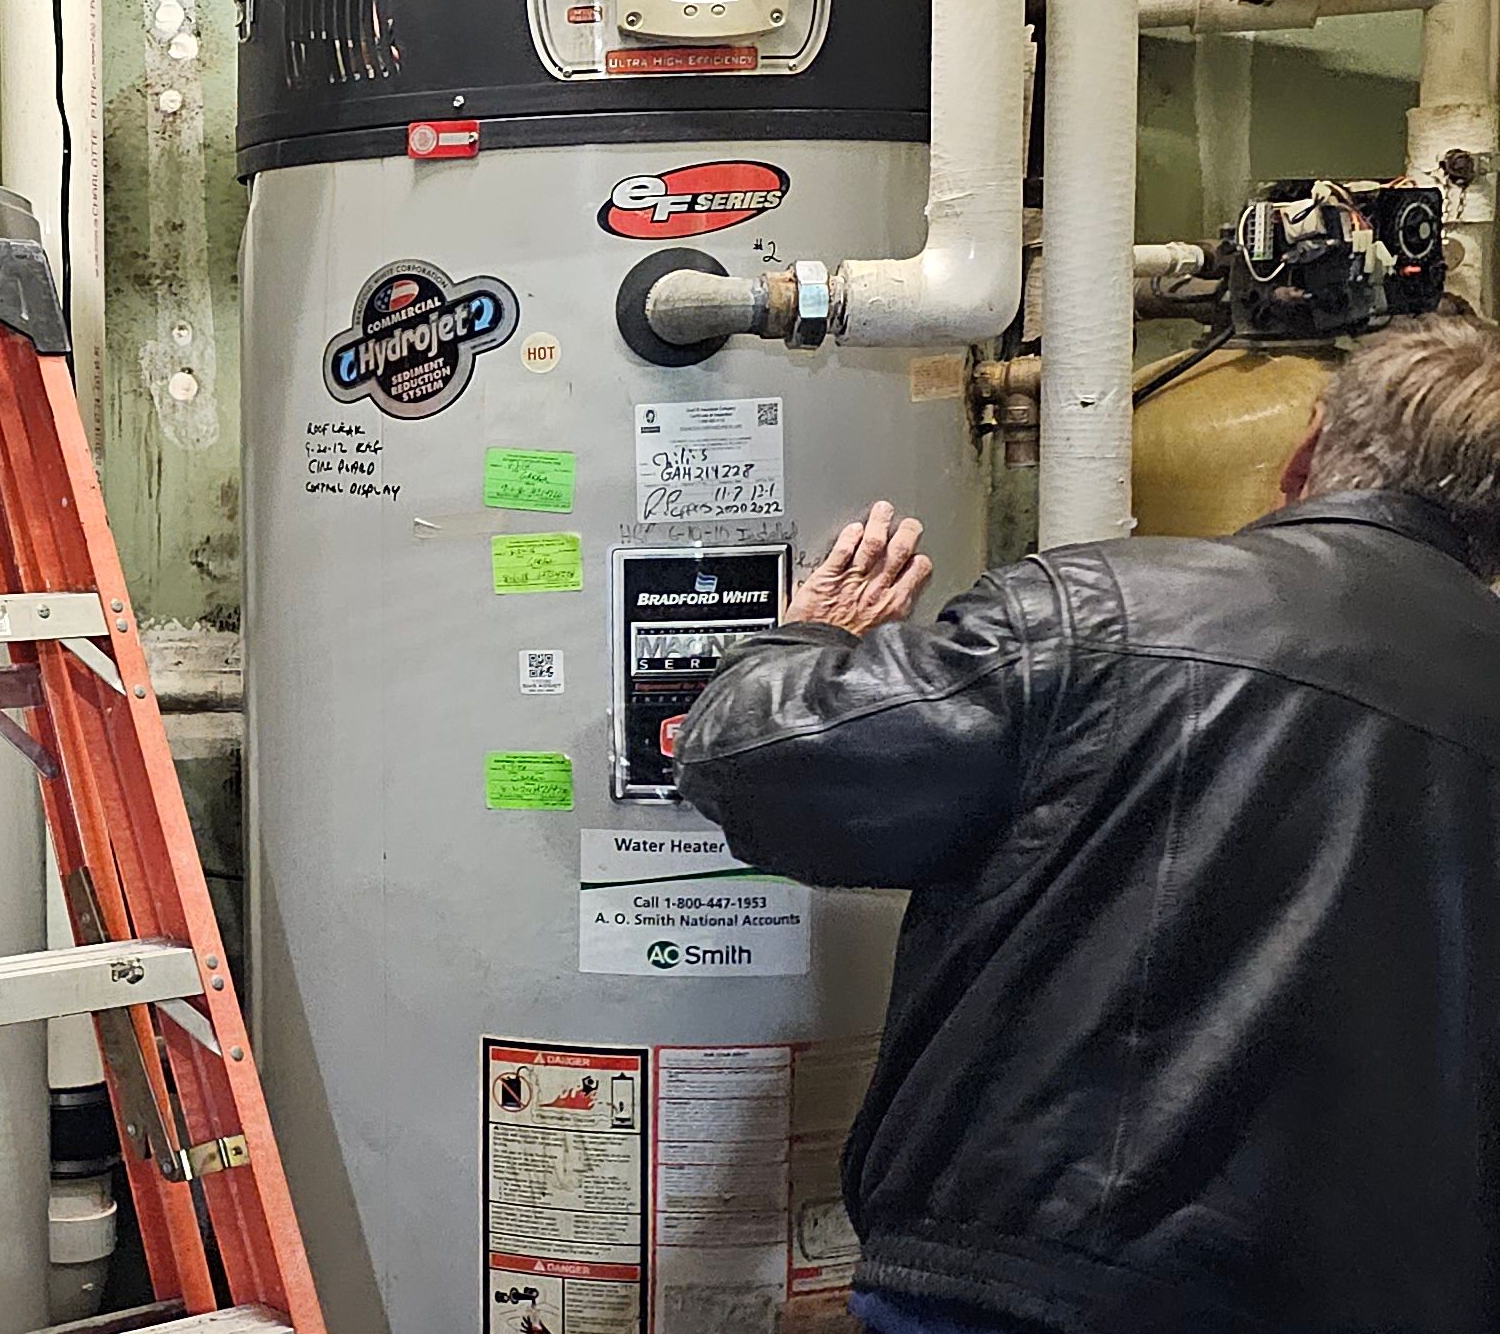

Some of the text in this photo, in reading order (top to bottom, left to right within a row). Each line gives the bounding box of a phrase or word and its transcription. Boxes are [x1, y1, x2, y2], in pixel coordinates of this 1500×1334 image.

[609, 54, 754, 68] ULTRA HIGH EFFICIENCY
[694, 190, 783, 211] SERIES
[395, 265, 448, 289] CORPORATION
[366, 296, 442, 334] COMMERCIAL
[358, 302, 469, 377] Hydrojet
[527, 346, 556, 361] HOT
[390, 365, 452, 396] REDUCTION
[391, 357, 445, 386] SEDIMENT
[402, 379, 444, 402] SYSTEM
[349, 482, 401, 502] DISPLAY
[636, 590, 770, 606] BRADFORD WHITE
[614, 837, 725, 853] Water Heater
[633, 896, 767, 909] Call 1-800-447-1953
[595, 912, 801, 927] A. O. Smith National Accounts
[685, 944, 752, 966] Smith
[546, 1055, 591, 1068] DANGER
[546, 1262, 591, 1276] DANGER
